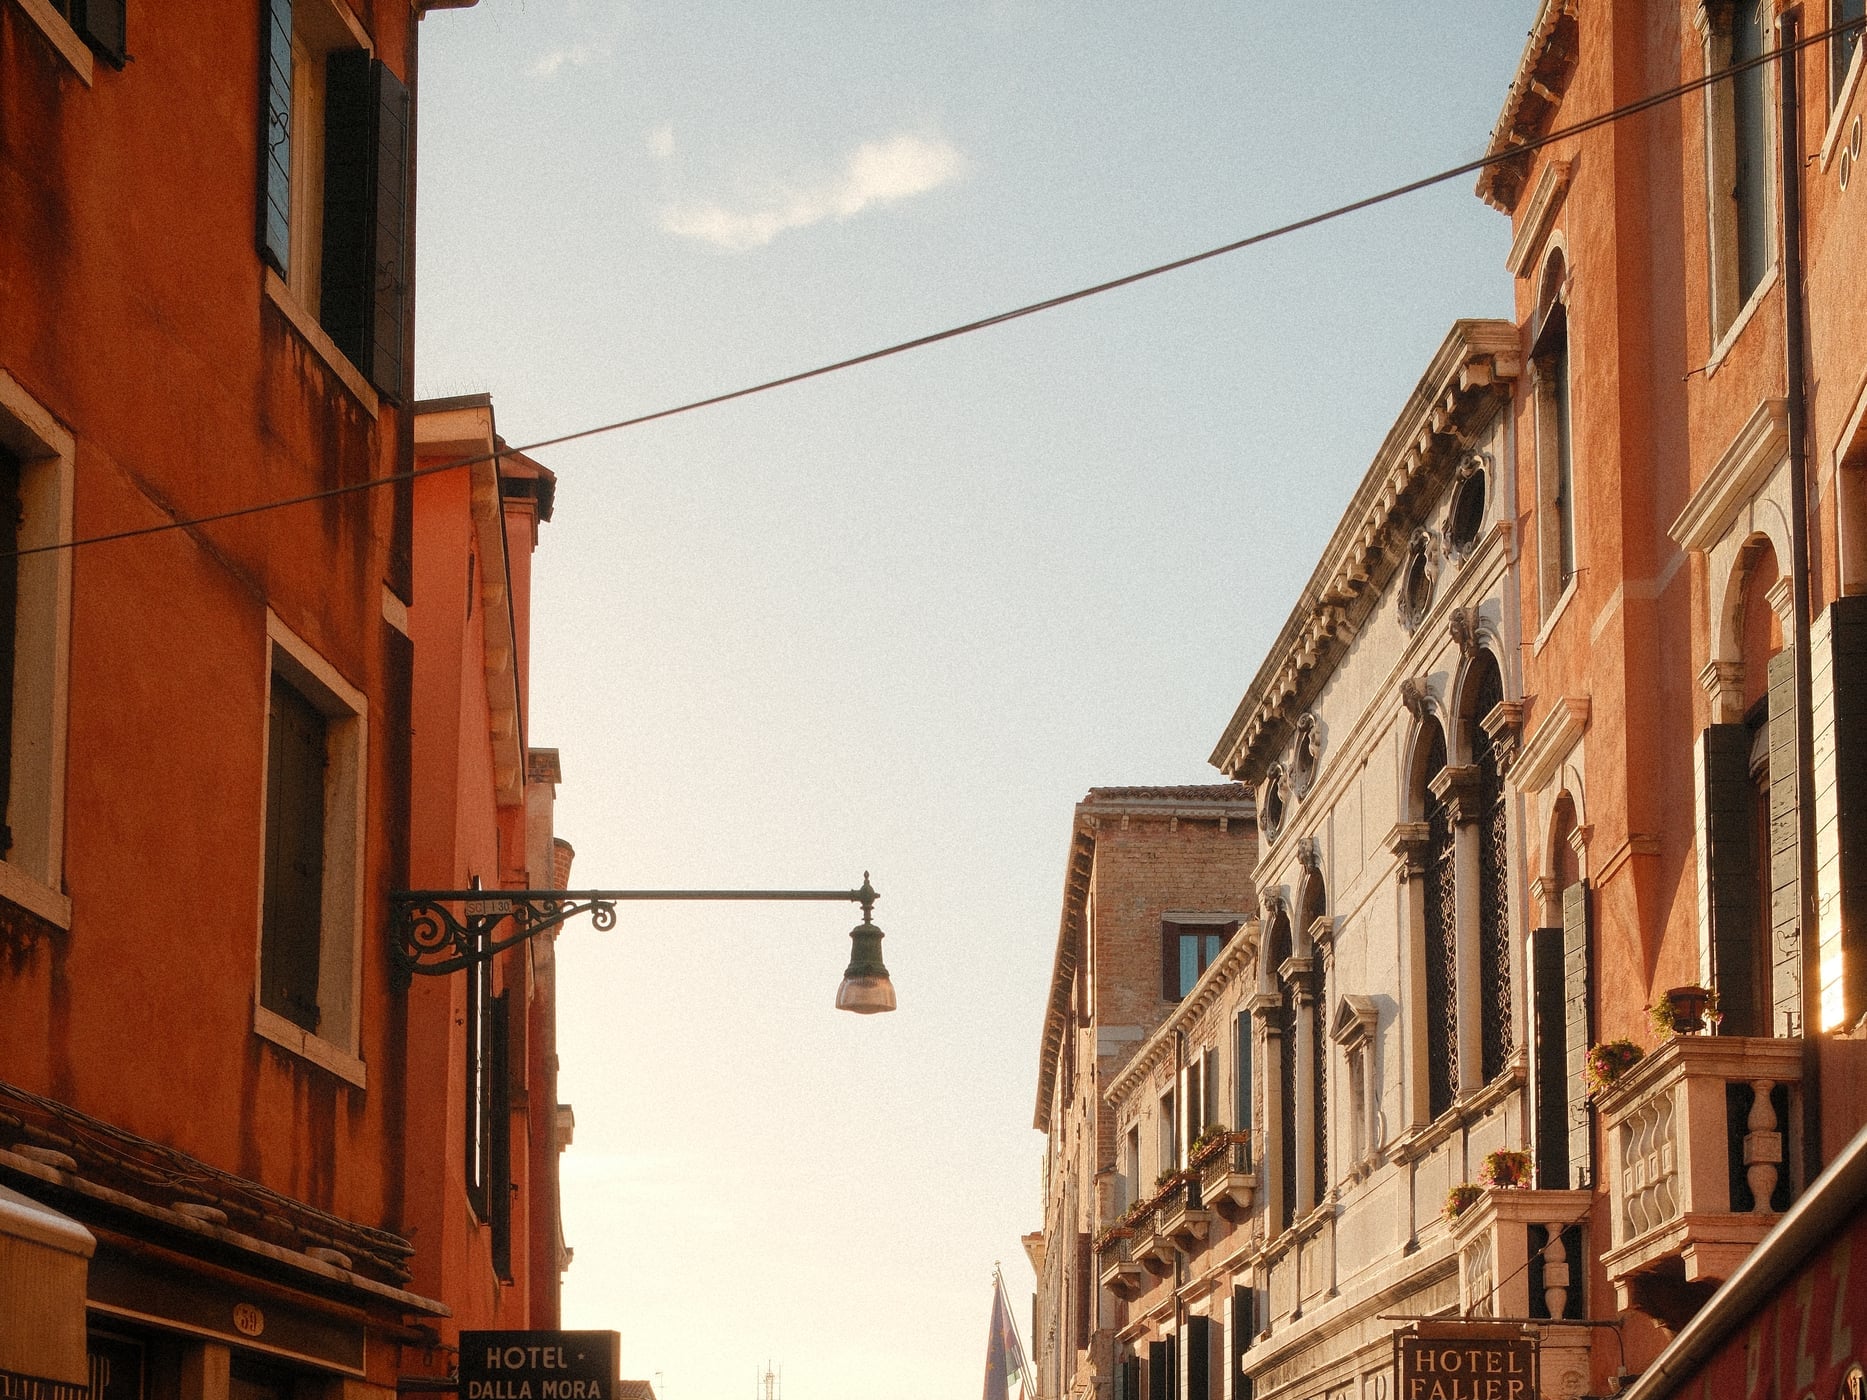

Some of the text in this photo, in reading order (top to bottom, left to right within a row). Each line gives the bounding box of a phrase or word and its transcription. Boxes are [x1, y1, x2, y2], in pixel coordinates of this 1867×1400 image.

[486, 1346, 568, 1370] HOTEL
[1415, 1349, 1524, 1374] HOTEL
[468, 1379, 602, 1400] DALLA MORA
